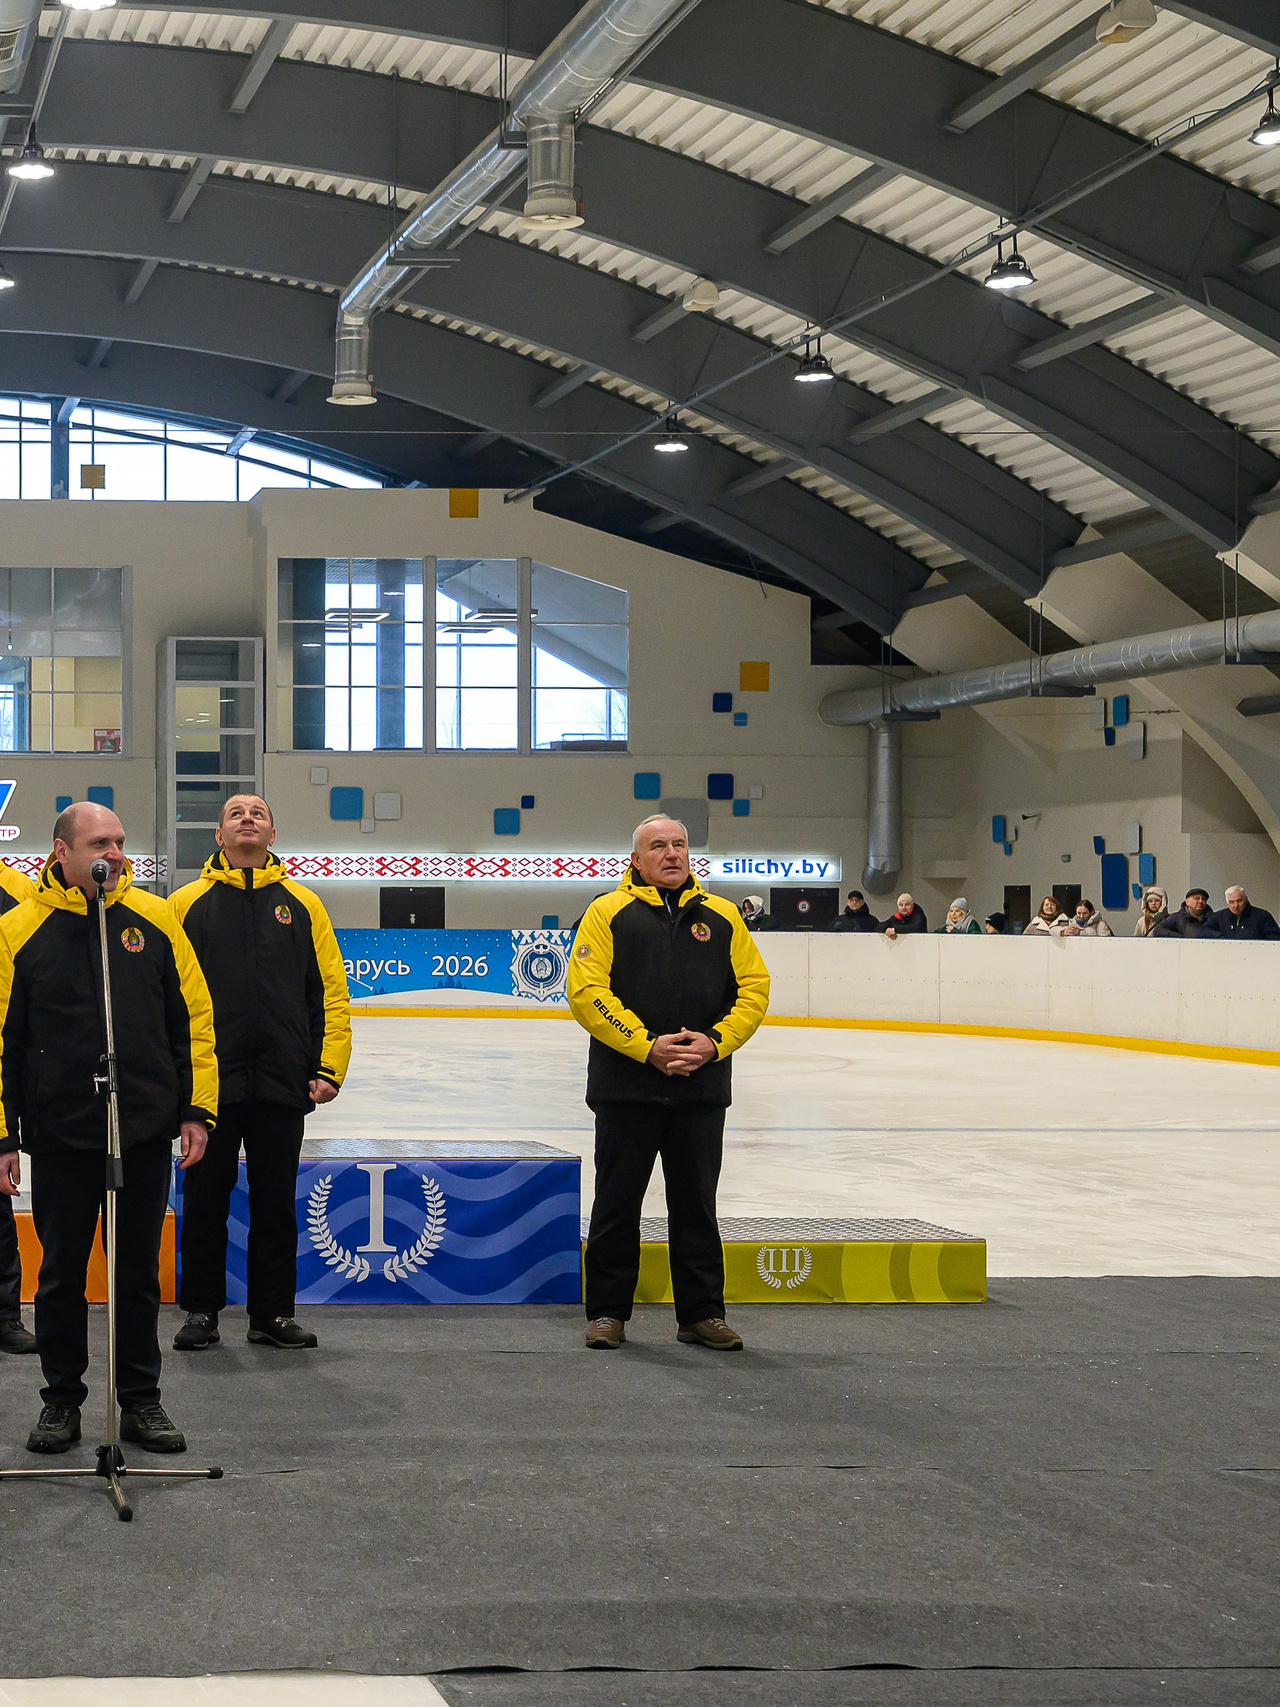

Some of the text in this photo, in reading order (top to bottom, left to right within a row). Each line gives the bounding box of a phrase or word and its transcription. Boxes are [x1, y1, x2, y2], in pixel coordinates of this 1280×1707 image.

[722, 858, 830, 878] silichy.by
[431, 955, 489, 977] 2026
[593, 998, 634, 1039] BELARUS
[356, 1163, 397, 1252] I
[766, 1248, 804, 1273] III
